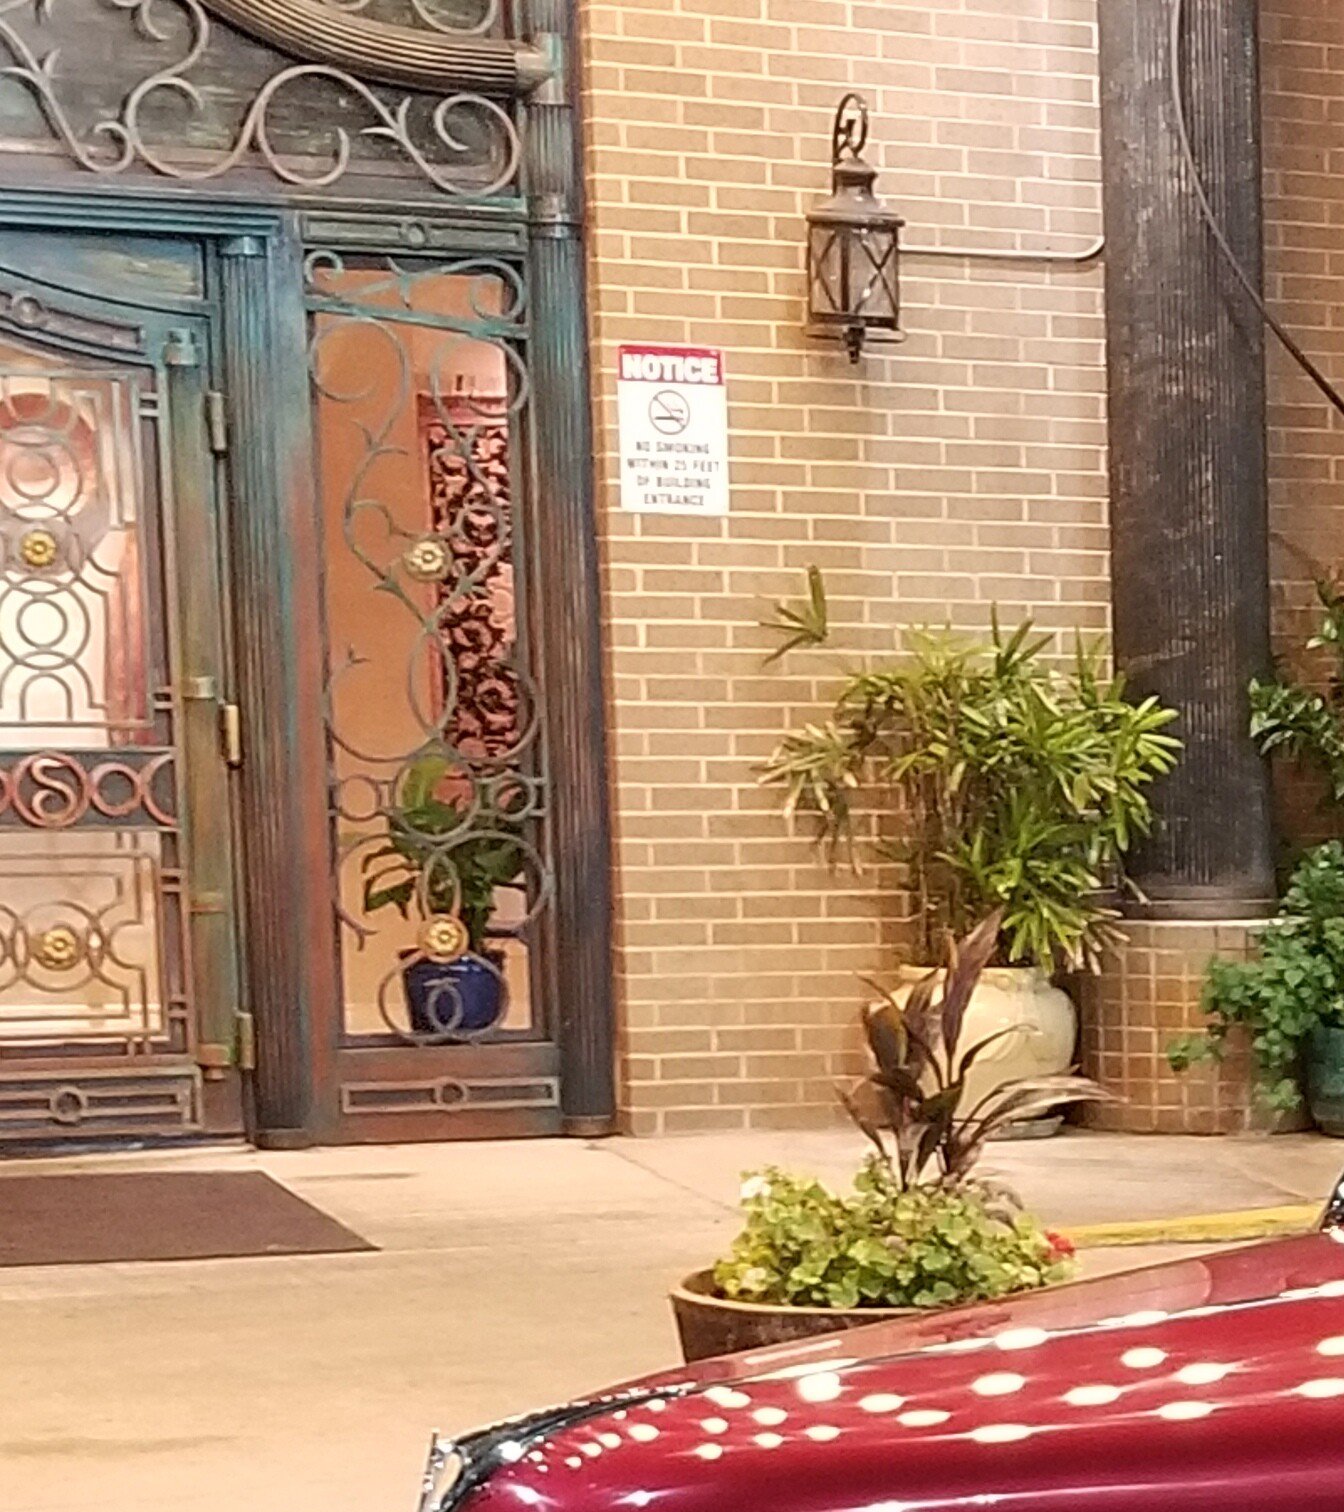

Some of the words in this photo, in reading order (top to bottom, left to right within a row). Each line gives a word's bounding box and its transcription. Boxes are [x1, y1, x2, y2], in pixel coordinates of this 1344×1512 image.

[622, 353, 718, 383] NOTICE
[636, 441, 650, 453] NO
[656, 441, 709, 454] SMOKING
[627, 458, 668, 470] WITHIN
[693, 461, 719, 473] FEET
[637, 475, 649, 487] OF
[656, 476, 711, 489] BUILDING
[644, 493, 704, 506] ENTRANCE
